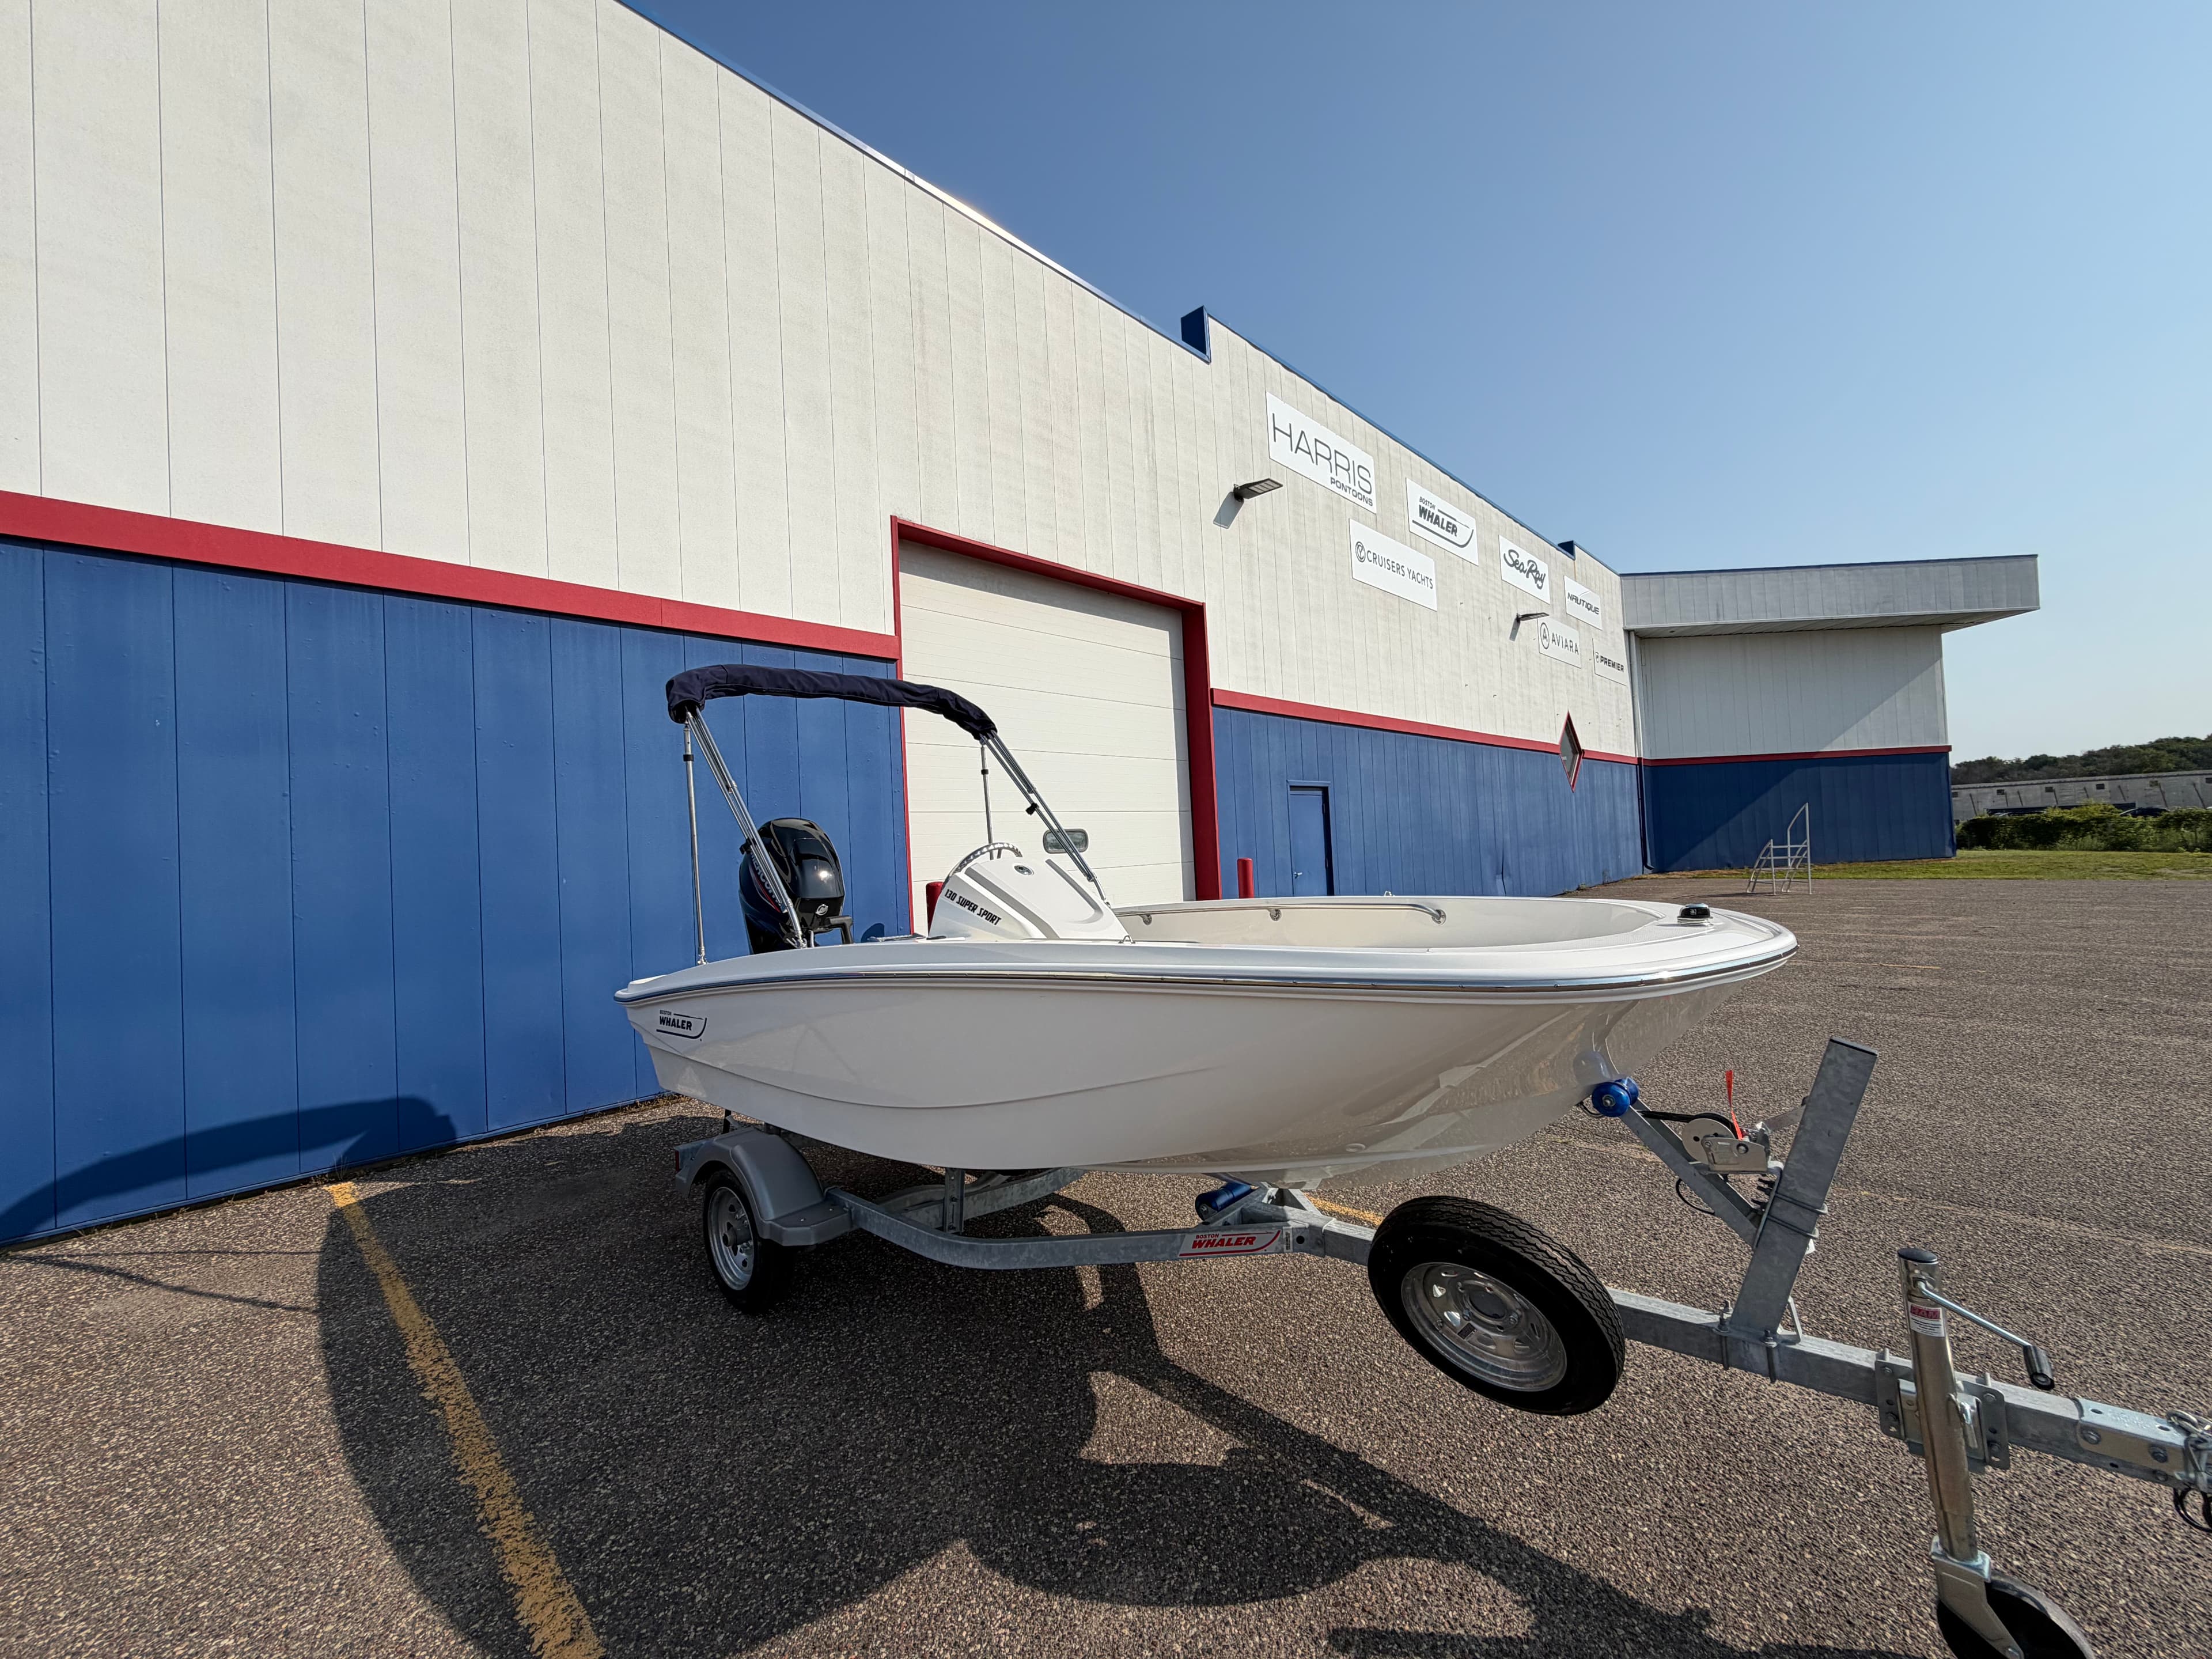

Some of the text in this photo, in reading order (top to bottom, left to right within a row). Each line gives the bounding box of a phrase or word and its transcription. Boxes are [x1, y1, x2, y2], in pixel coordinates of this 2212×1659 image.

[1272, 412, 1372, 495] HARRIS
[1330, 476, 1373, 507] PONTOONS
[1419, 496, 1436, 510] BOSTON
[1418, 505, 1458, 537] WHALER
[1366, 550, 1434, 589] CRUISERS YACHTS
[1567, 592, 1600, 615] NAUTIQUE
[1551, 632, 1580, 656] AVIARA
[1600, 655, 1624, 673] PREMIER
[945, 889, 1002, 926] 130 SUPER SPORT
[659, 1016, 692, 1031] WHALER
[1191, 1236, 1256, 1249] WHALER
